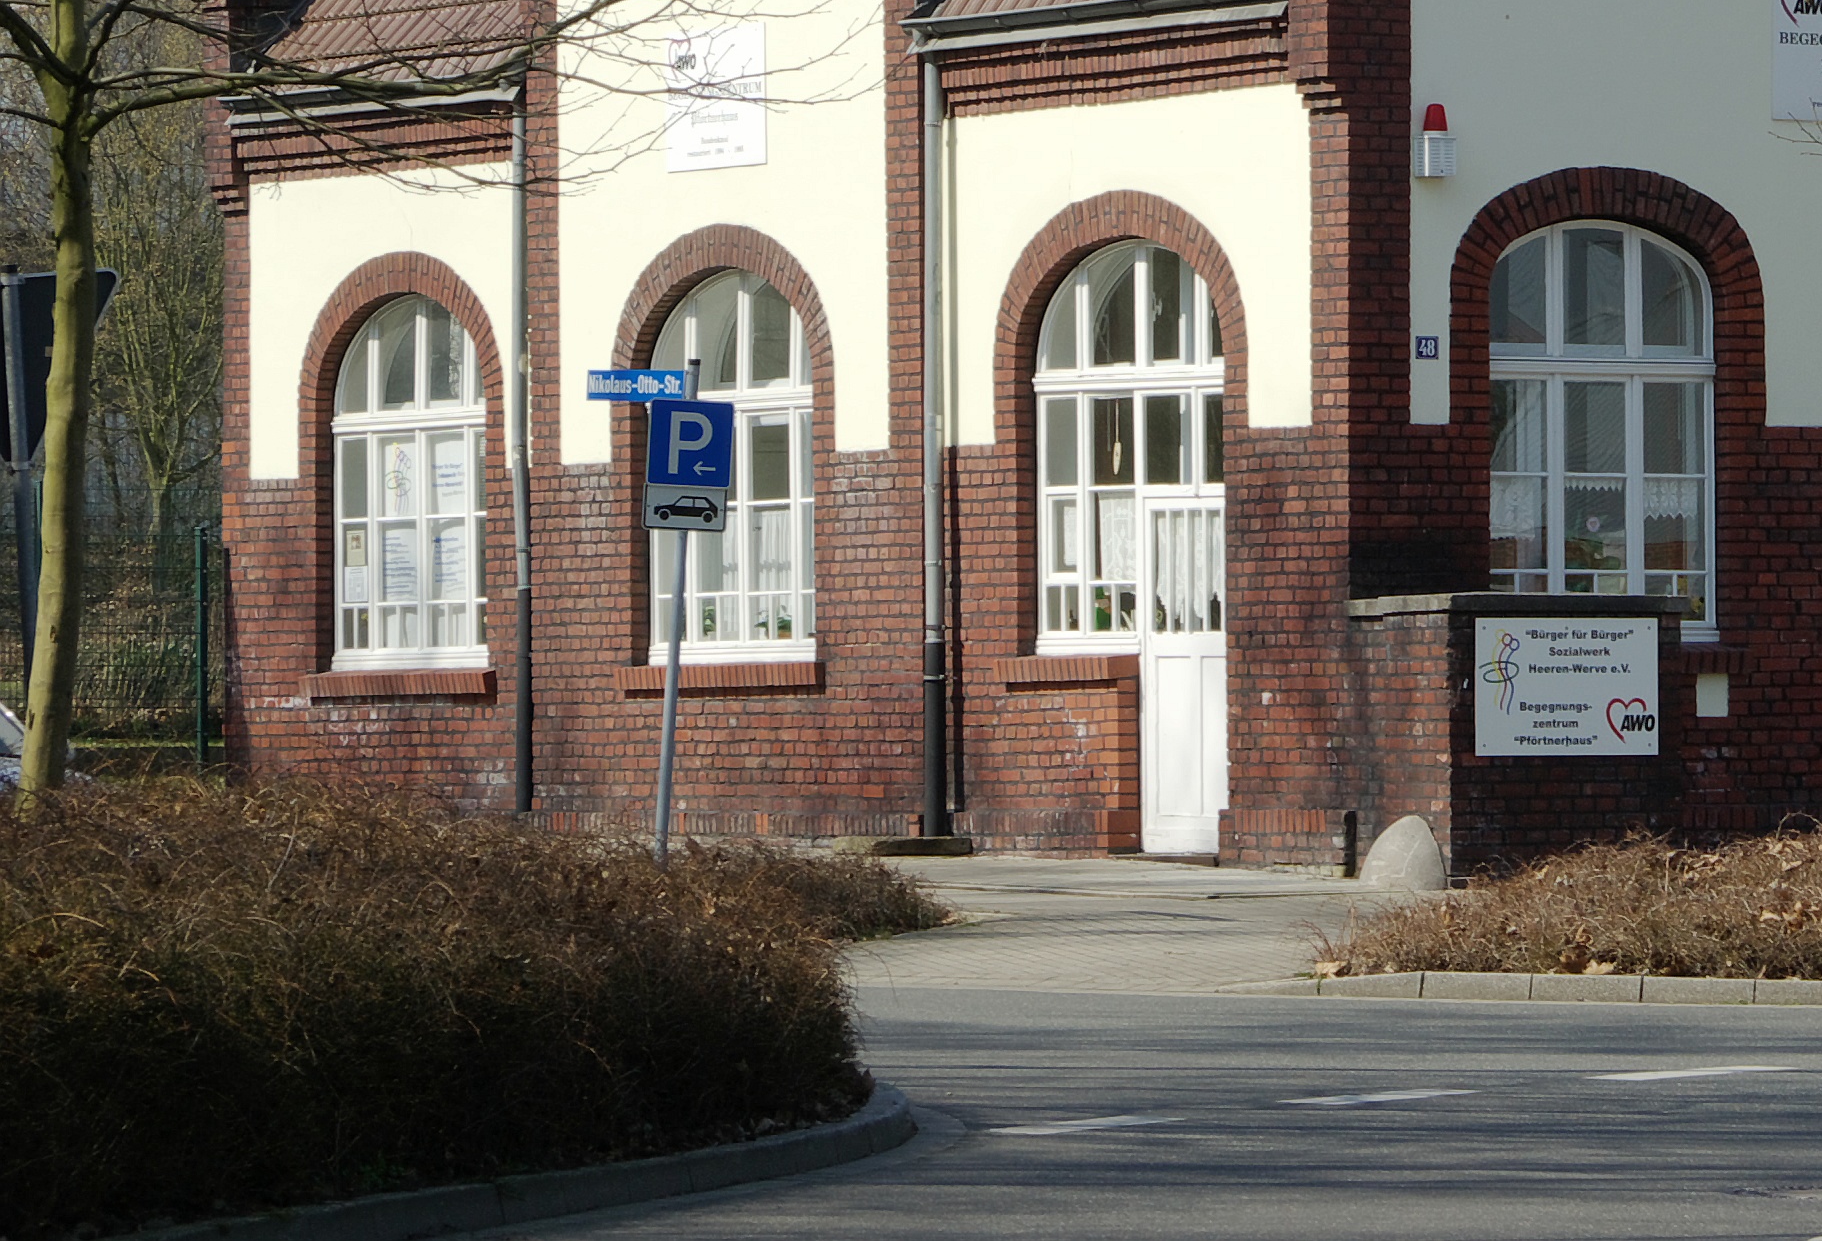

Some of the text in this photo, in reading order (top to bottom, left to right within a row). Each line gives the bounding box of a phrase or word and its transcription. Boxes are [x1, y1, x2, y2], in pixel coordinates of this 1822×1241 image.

[1418, 339, 1435, 356] 48
[588, 374, 683, 395] Nikolaus-Otto-Str.
[667, 410, 714, 475] P
[1571, 629, 1588, 639] für
[1548, 646, 1611, 657] Sozialwerk
[1528, 663, 1632, 674] Heeren-Werve e.V.
[1519, 701, 1593, 713] Begegnungs-
[1532, 719, 1579, 728] zentrum
[1620, 714, 1656, 731] AWO
